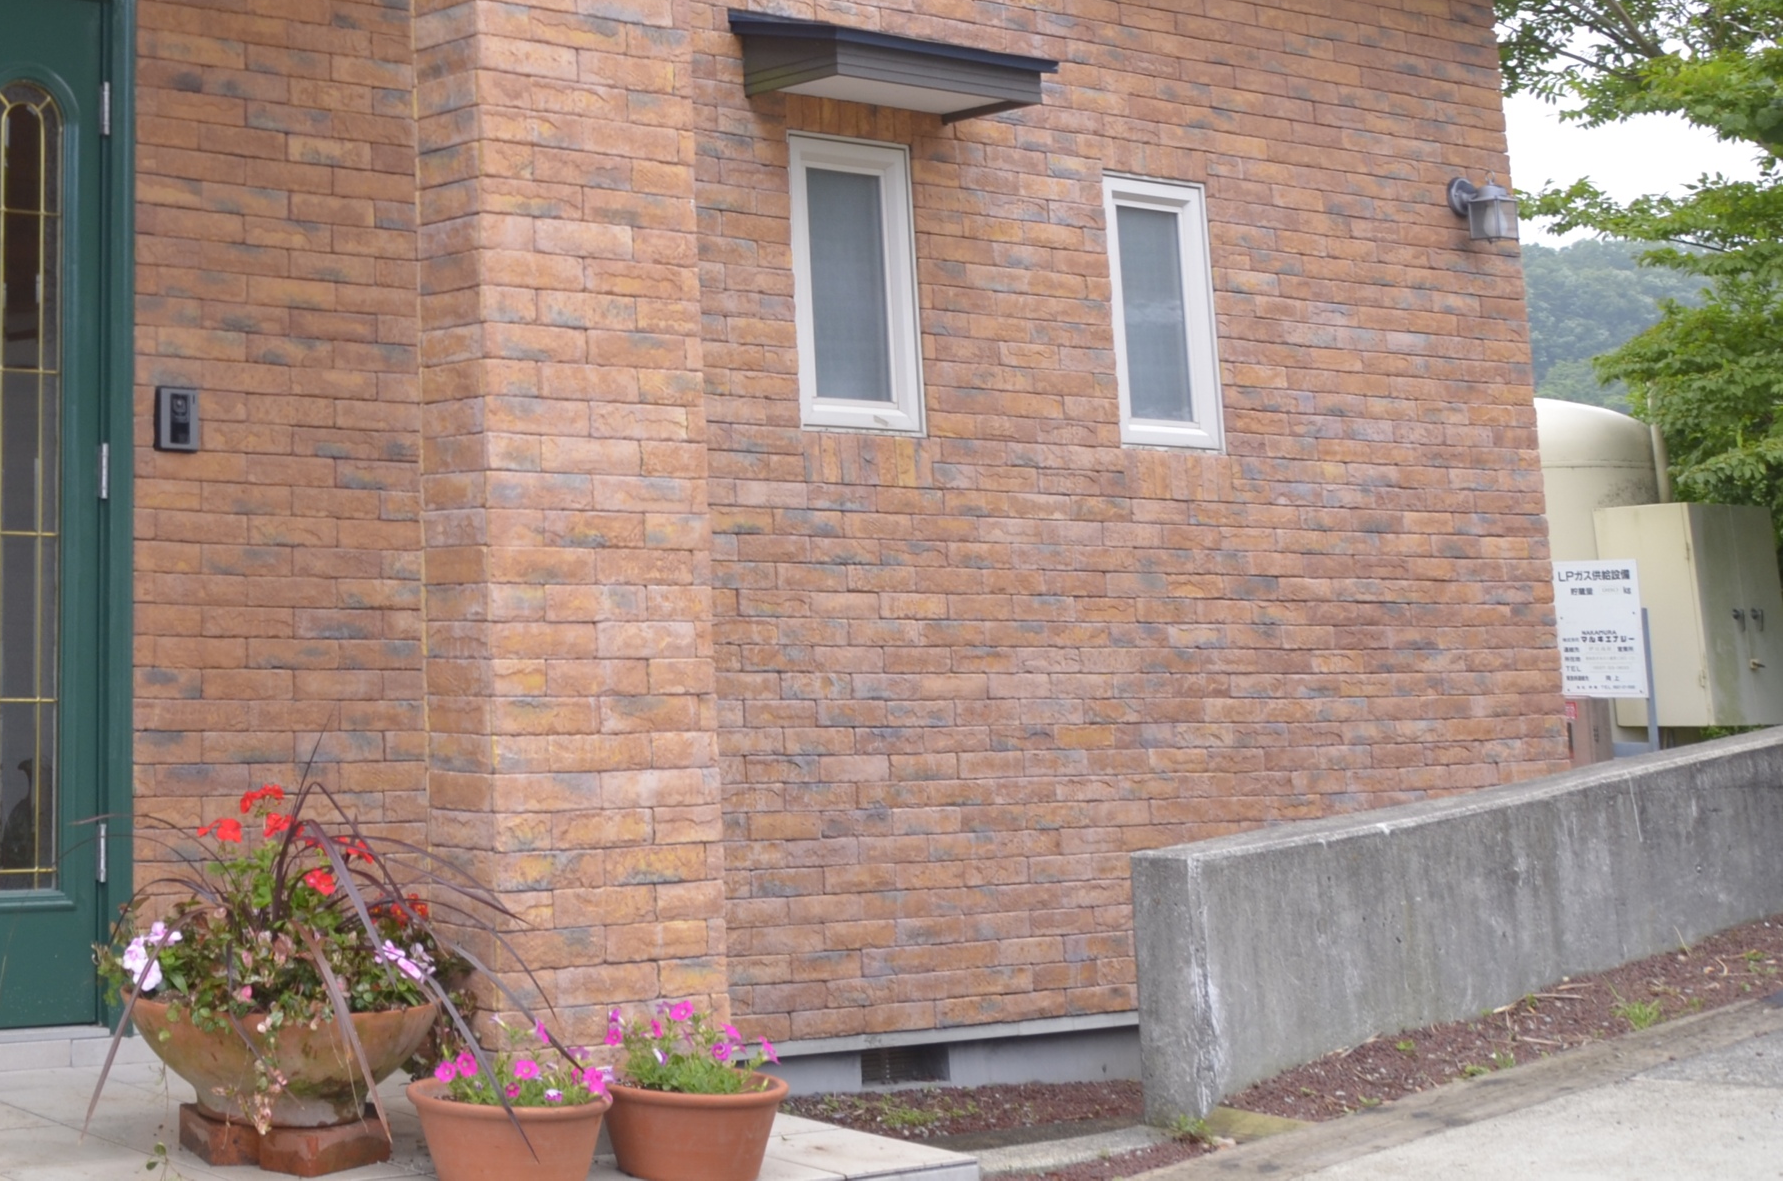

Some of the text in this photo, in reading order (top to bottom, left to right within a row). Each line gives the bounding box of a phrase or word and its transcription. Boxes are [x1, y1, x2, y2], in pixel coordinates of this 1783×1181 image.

[1558, 569, 1630, 582] LPガス供給設備
